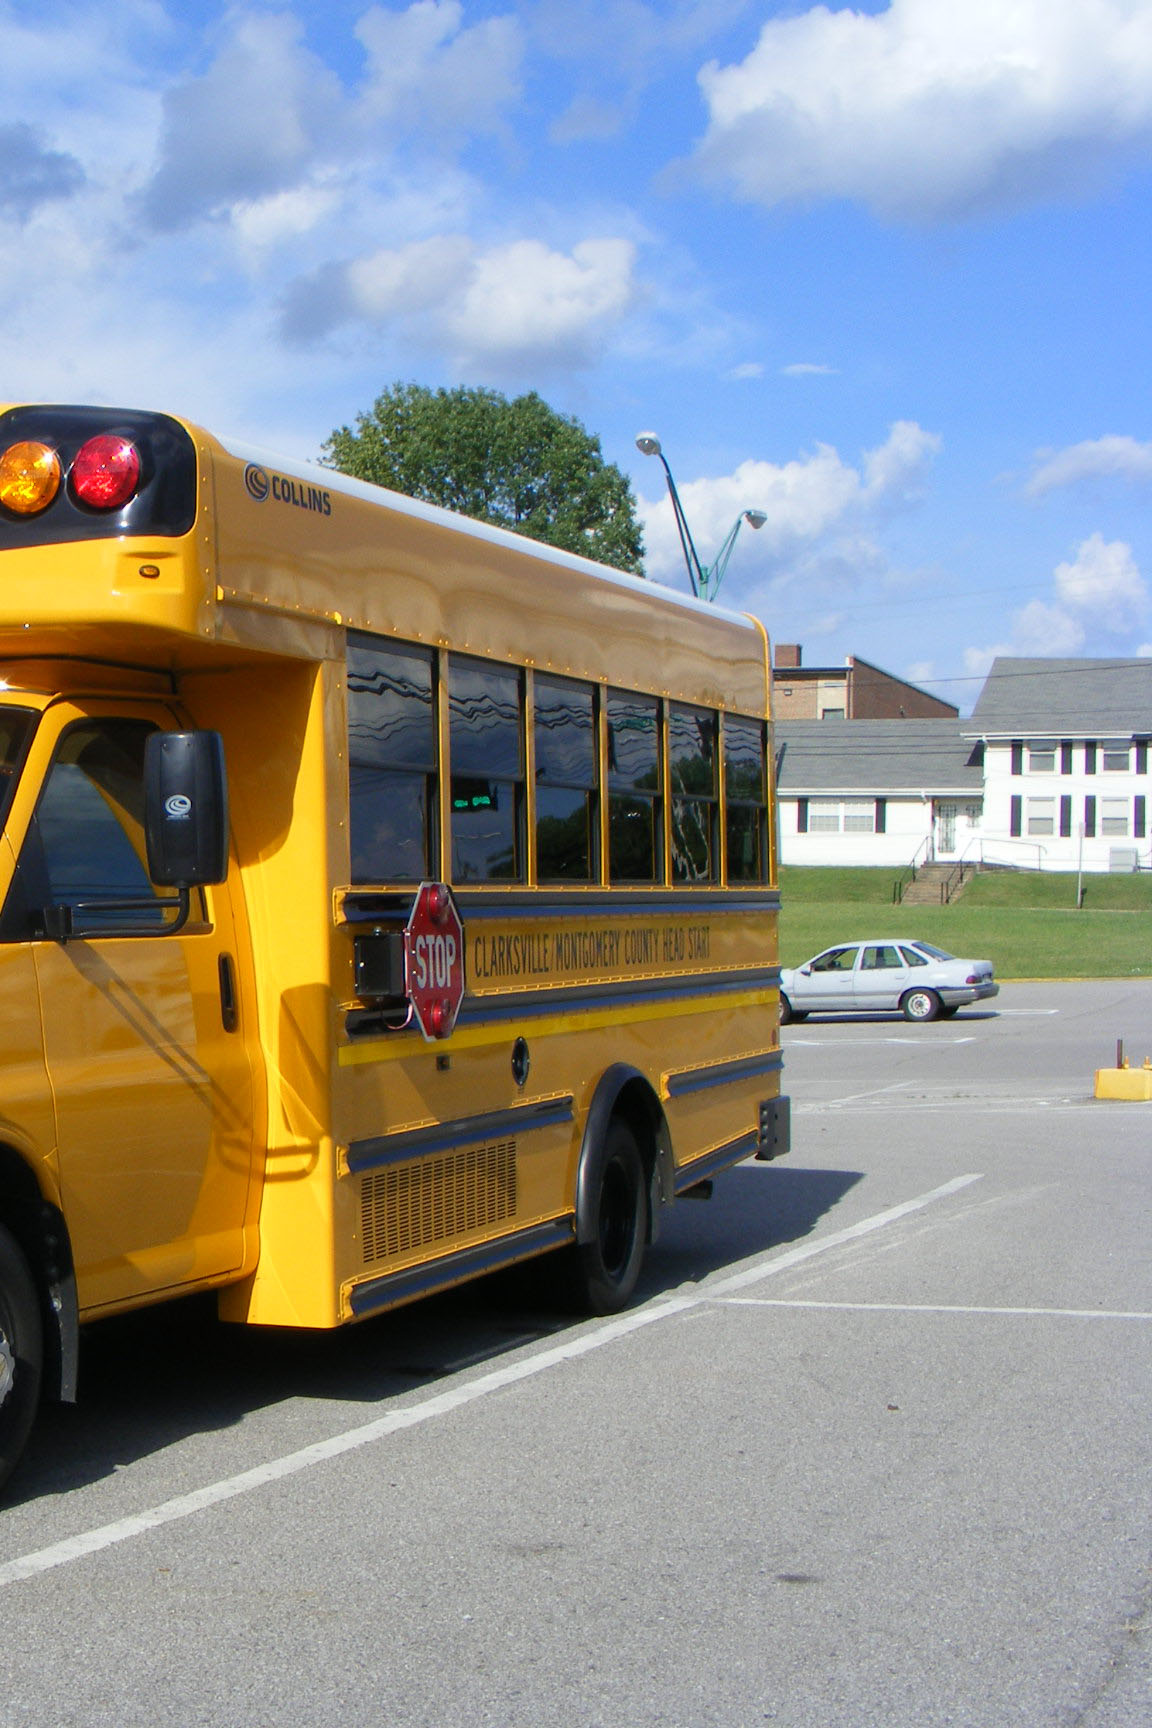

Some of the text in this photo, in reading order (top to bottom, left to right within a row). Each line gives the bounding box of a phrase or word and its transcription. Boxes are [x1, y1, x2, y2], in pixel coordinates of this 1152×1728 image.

[272, 475, 332, 516] COLLINS
[415, 935, 456, 989] STOP
[624, 928, 659, 965] COUNTY
[663, 927, 685, 962] HEAD
[688, 926, 710, 960] START
